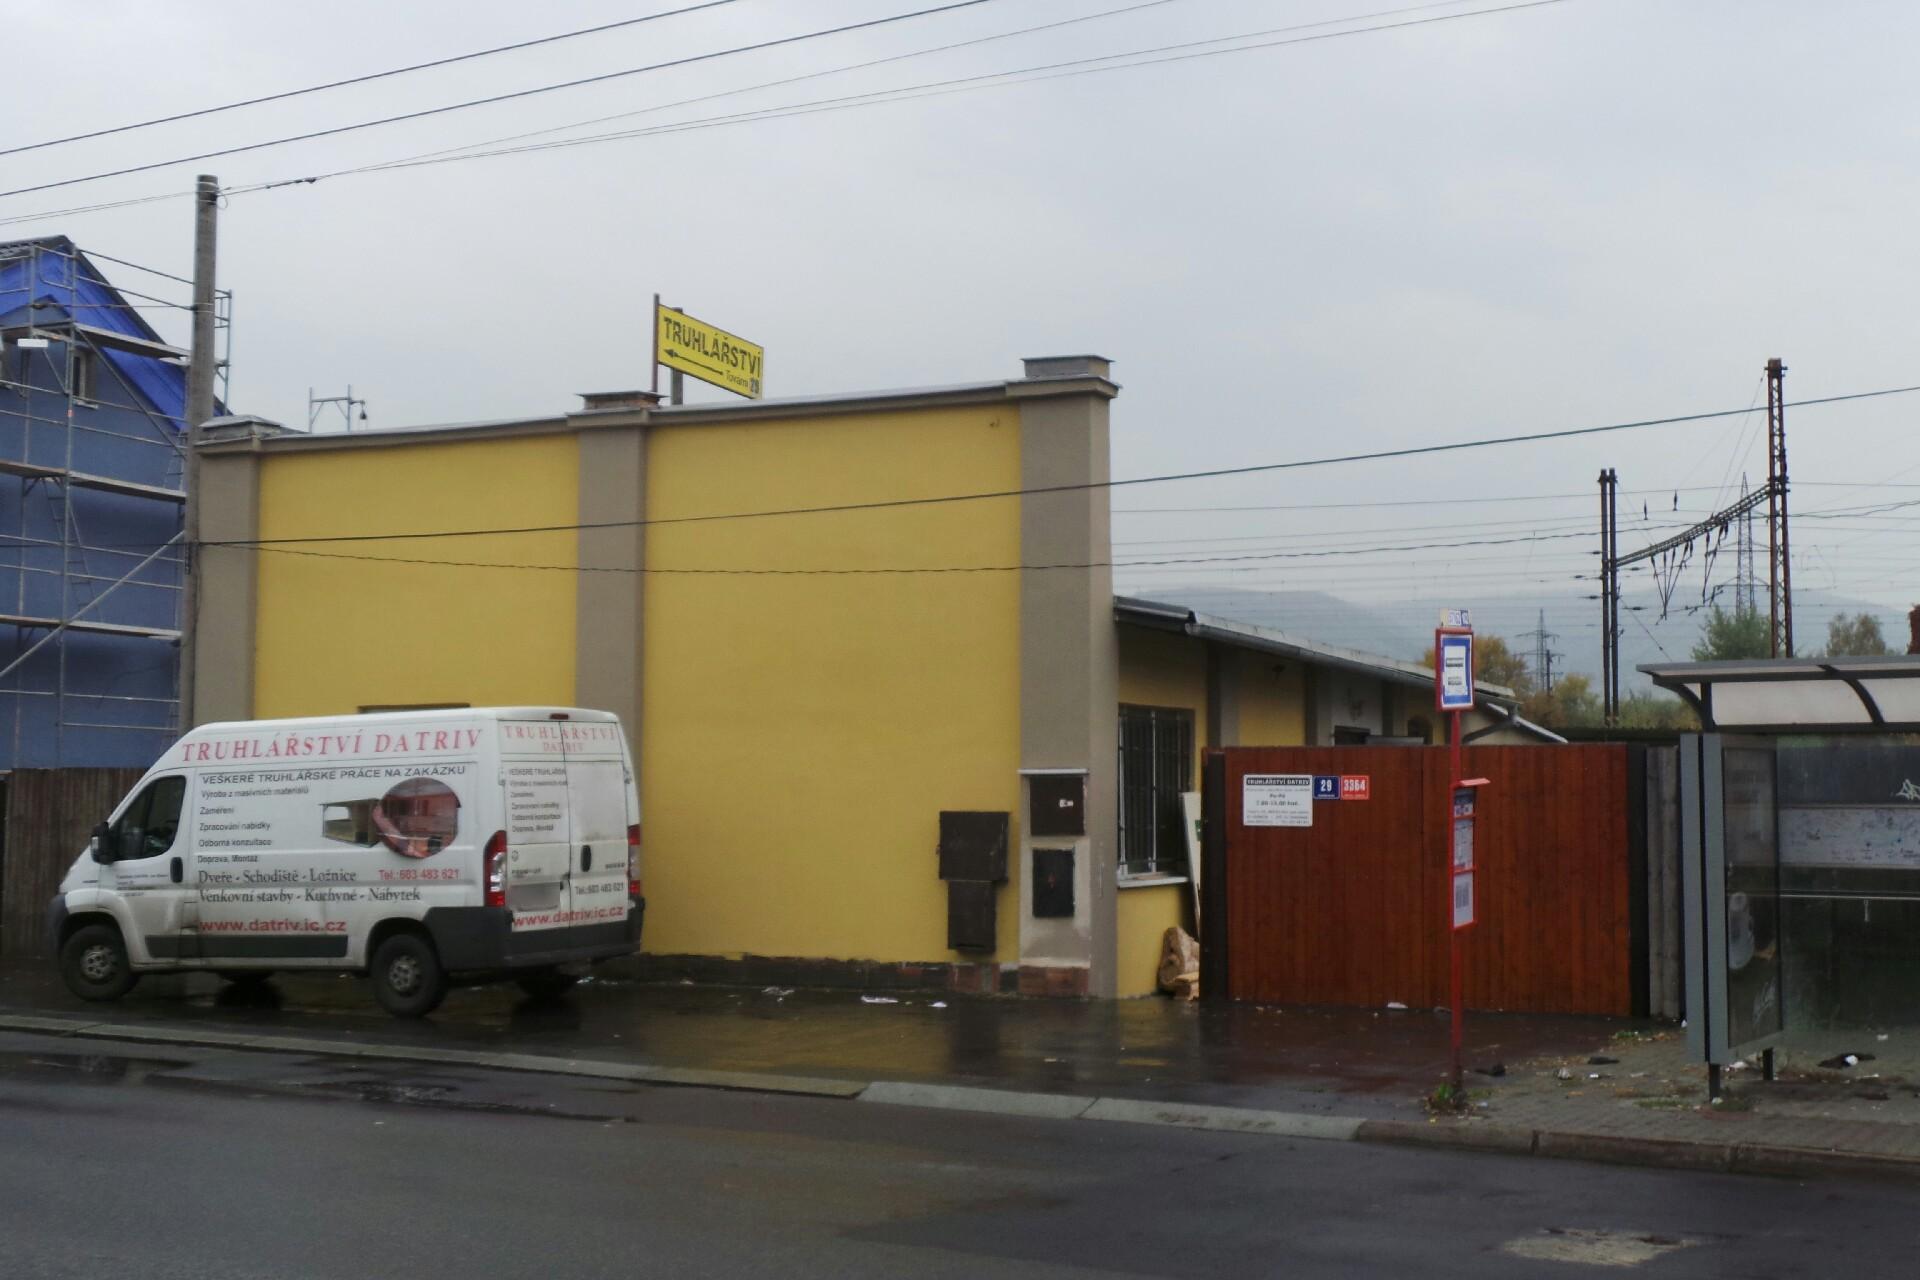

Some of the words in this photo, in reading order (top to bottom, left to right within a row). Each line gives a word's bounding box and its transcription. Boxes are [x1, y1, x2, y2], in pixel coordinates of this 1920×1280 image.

[664, 316, 760, 378] TRUHLÁŘSTVÍ
[182, 729, 363, 762] TRUHLÁŘSTVÍ
[374, 729, 482, 753] DATRIV
[340, 768, 381, 779] PRÁCE
[384, 768, 401, 777] NA
[404, 765, 465, 777] ZAKÁZKU
[1320, 779, 1332, 792] 29
[198, 870, 233, 883] Dveře
[243, 869, 299, 883] Schodiště
[309, 868, 357, 882] Ložnice
[257, 889, 294, 904] stavby
[369, 887, 421, 903] Nábytek
[513, 906, 624, 926] www.datriv.ic.cz
[201, 918, 347, 932] www.datriv.ic.cz
